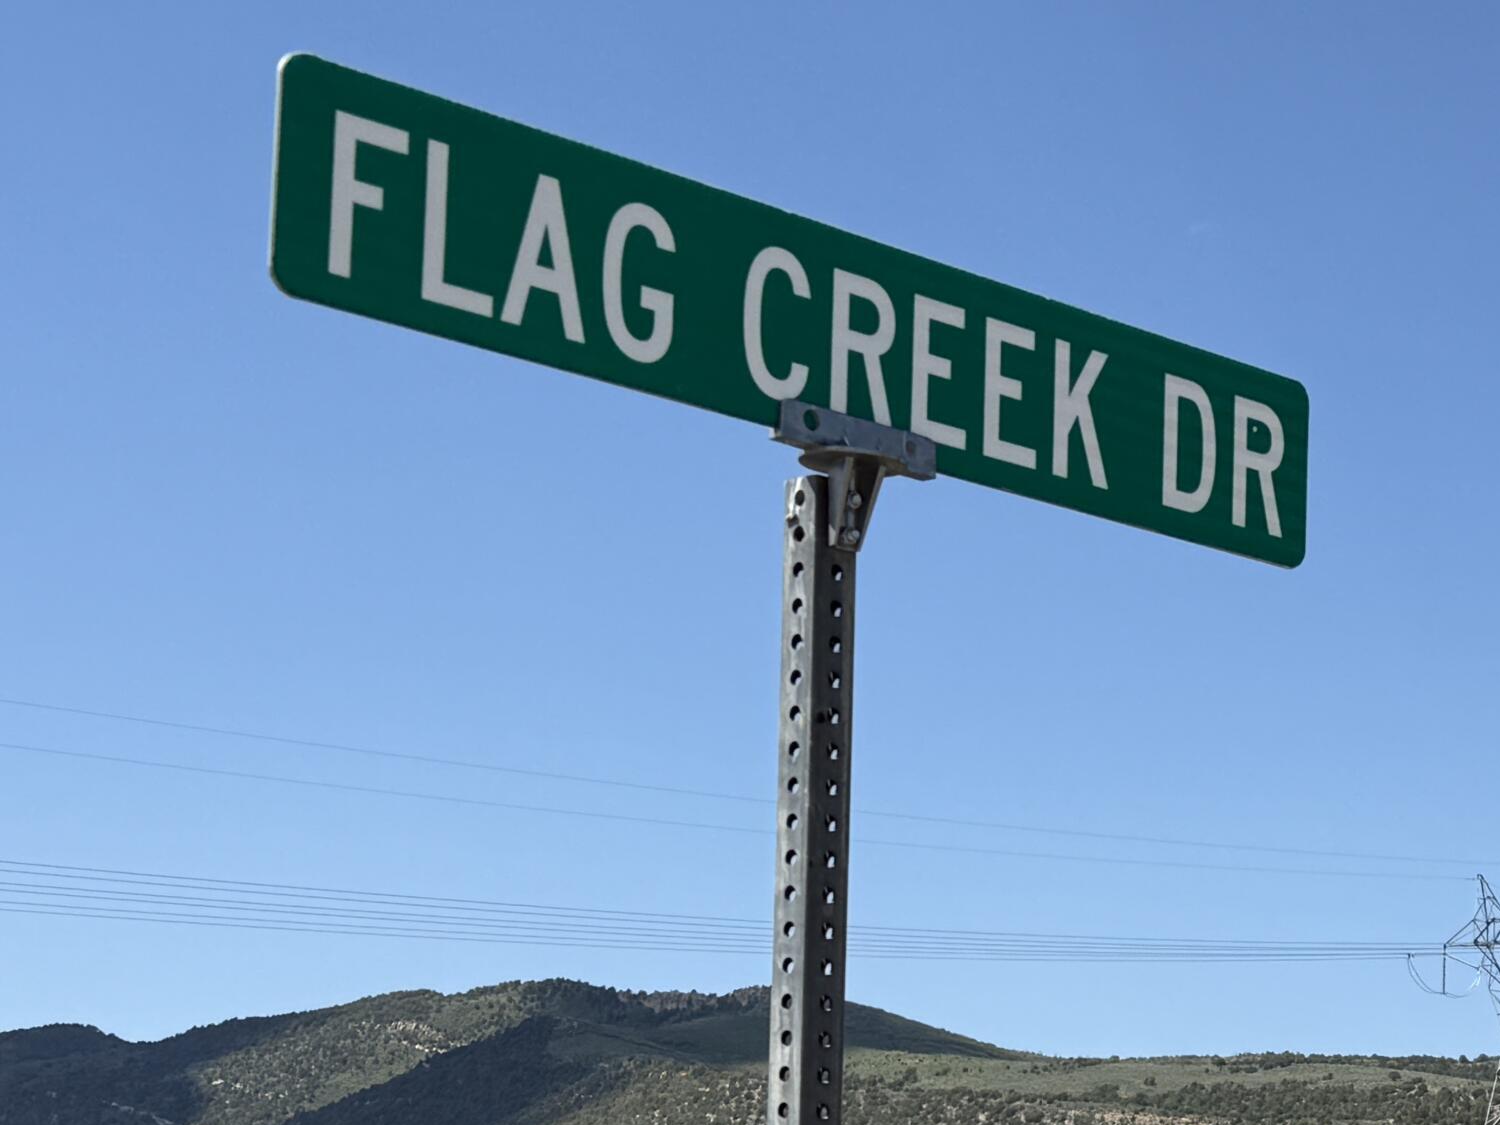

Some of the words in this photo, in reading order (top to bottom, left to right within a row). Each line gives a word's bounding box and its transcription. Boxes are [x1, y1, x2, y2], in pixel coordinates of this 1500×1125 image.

[327, 109, 676, 364] FLAG
[742, 245, 1109, 490] CREEK
[1161, 373, 1285, 538] DR
